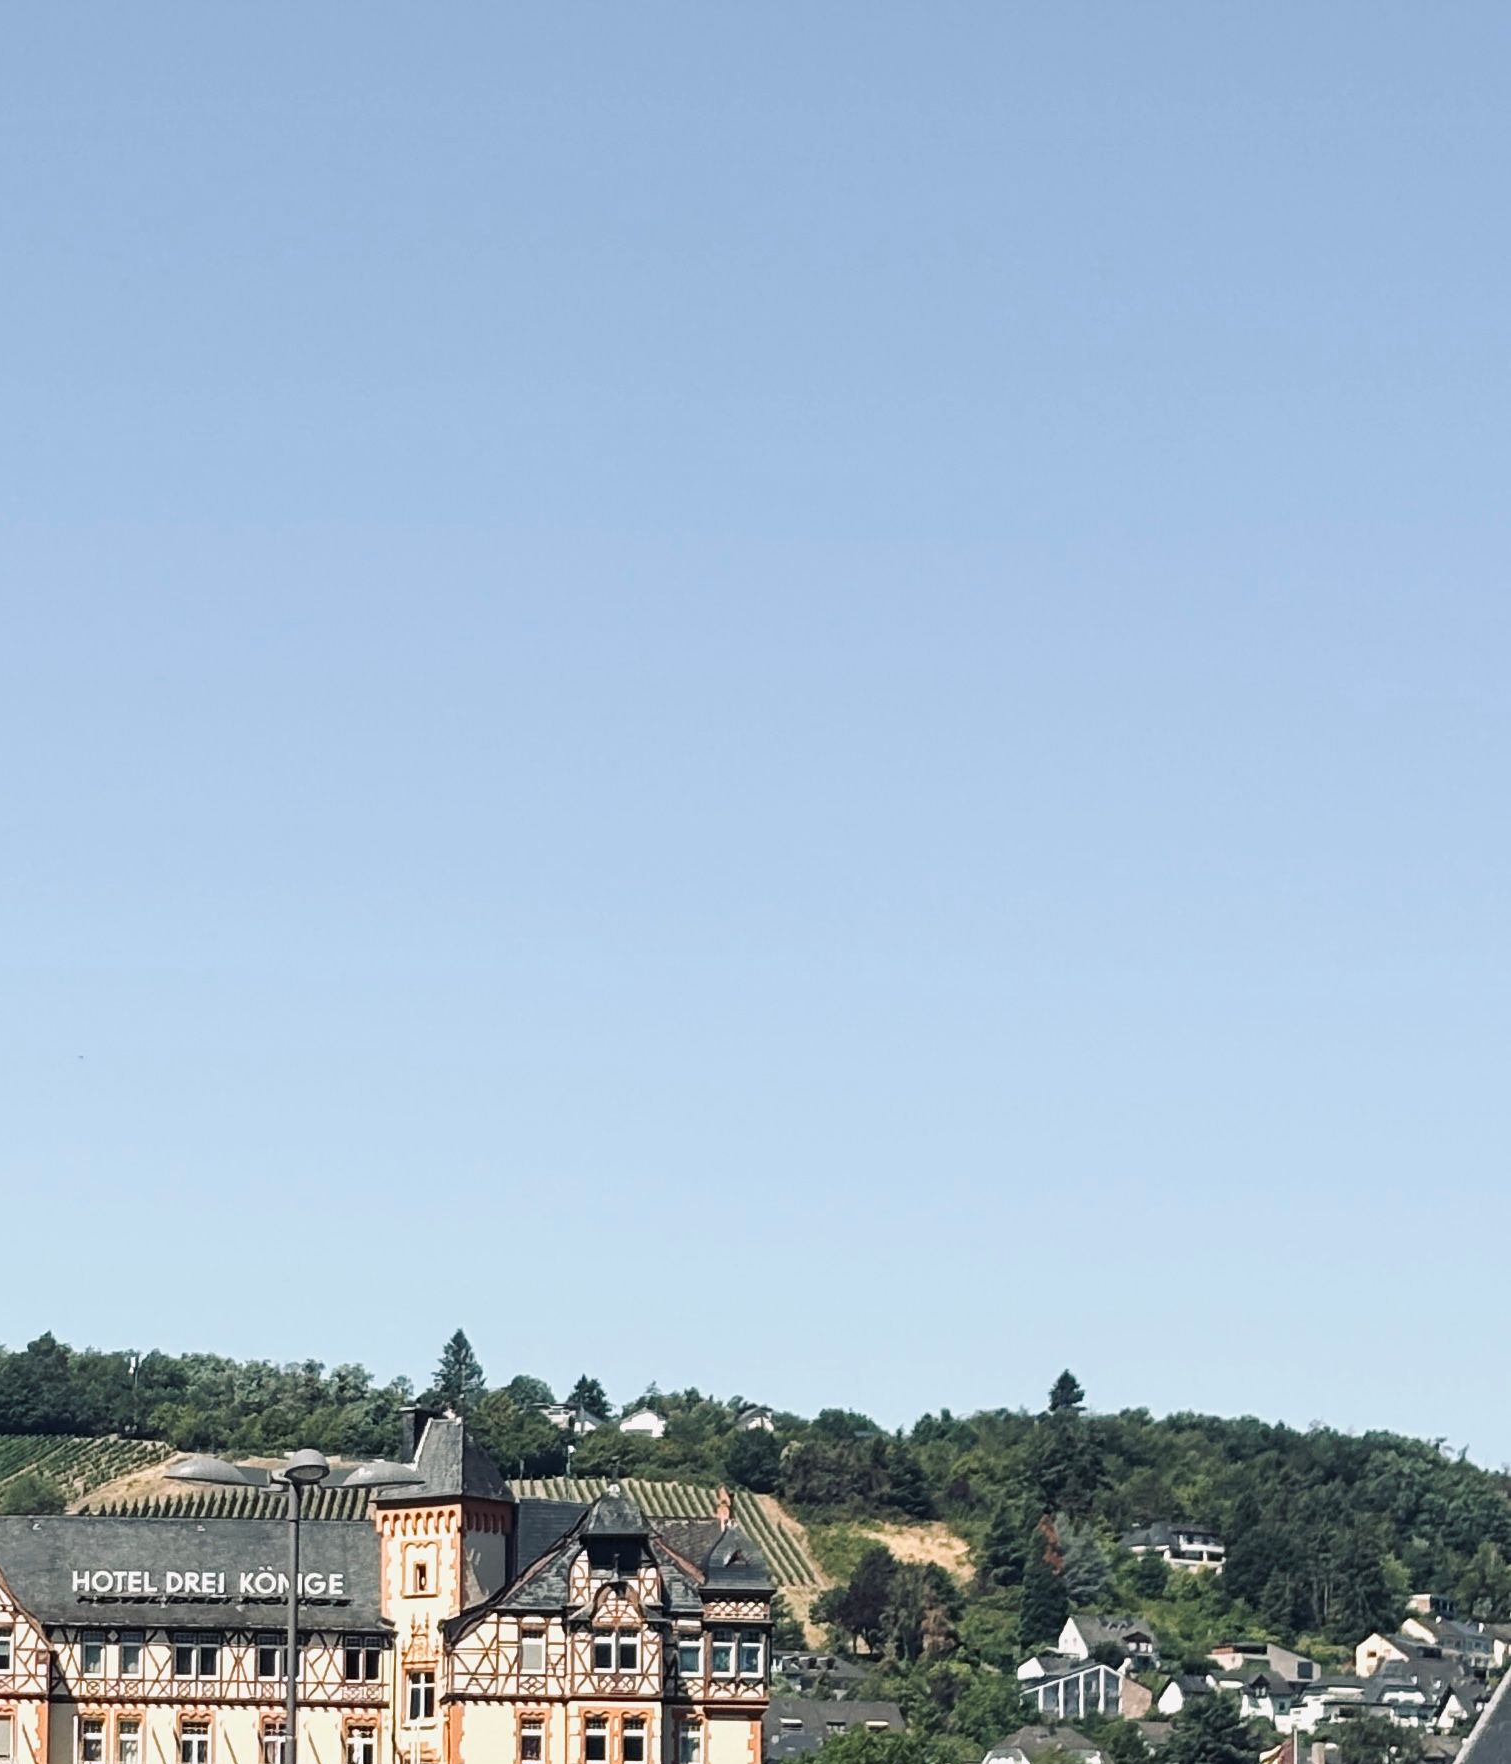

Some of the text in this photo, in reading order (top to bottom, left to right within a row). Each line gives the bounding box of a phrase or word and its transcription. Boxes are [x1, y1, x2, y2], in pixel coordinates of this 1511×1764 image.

[72, 1566, 343, 1595] HOTEL DREI KÖNIGE
